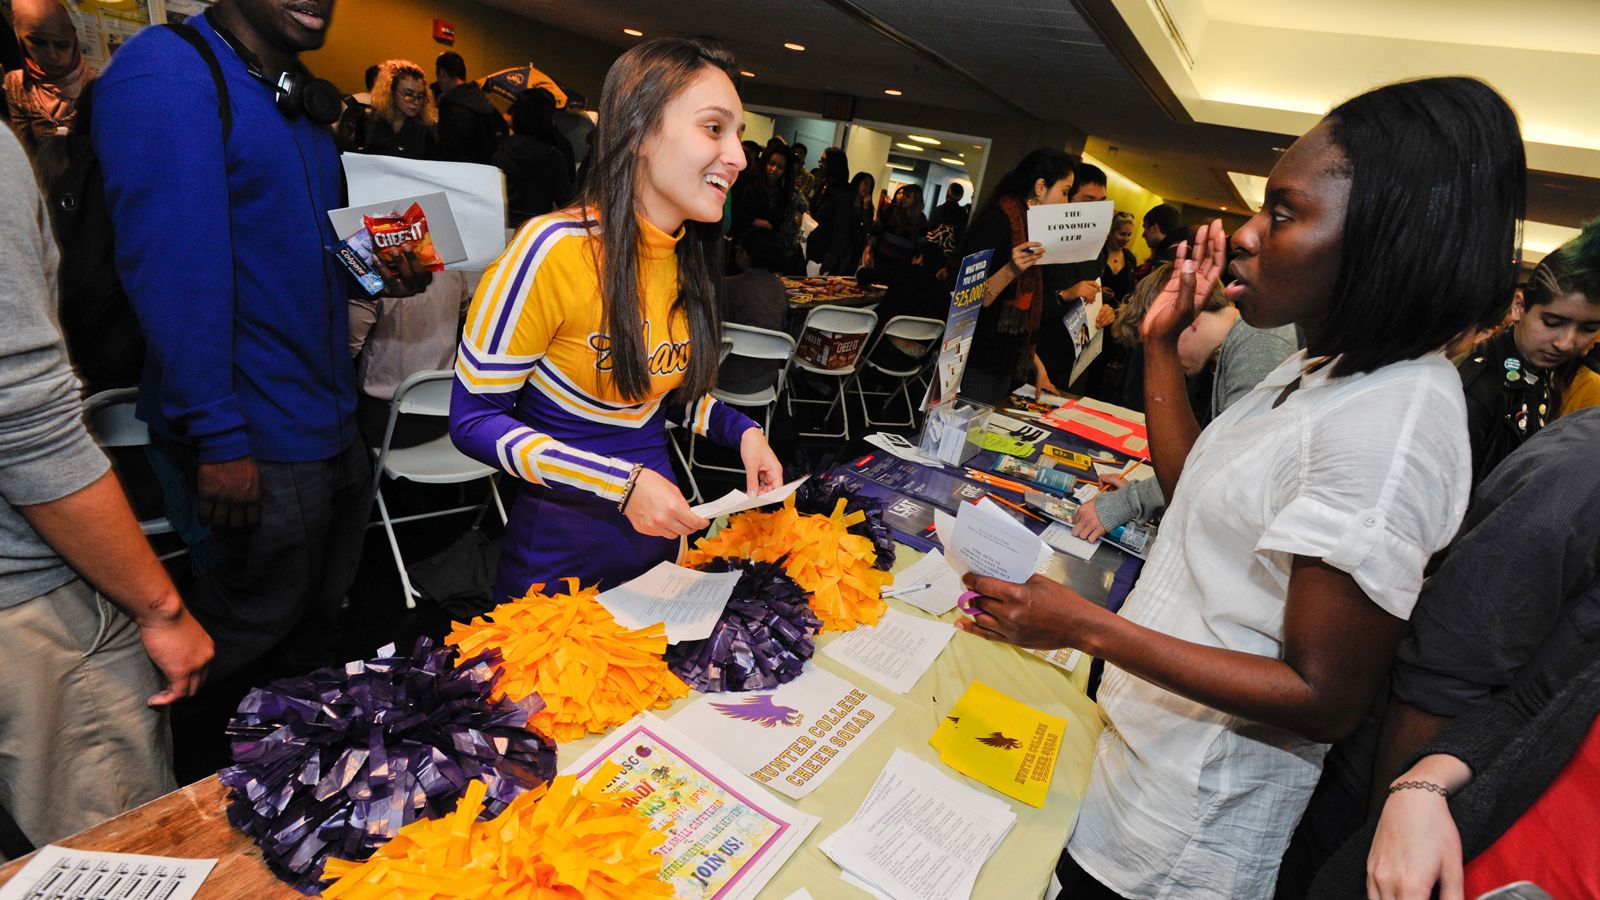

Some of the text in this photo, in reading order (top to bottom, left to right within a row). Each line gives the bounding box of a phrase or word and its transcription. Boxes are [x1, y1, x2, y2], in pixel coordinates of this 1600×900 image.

[1047, 221, 1097, 231] ECONOMICS
[1060, 234, 1082, 242] CLUB
[1064, 210, 1082, 218] THE
[340, 248, 366, 276] Colgate
[750, 688, 868, 783] HUNTER COLLEGE
[786, 708, 876, 787] CHEER SQUAD
[1014, 752, 1036, 785] HUNTER
[1028, 722, 1048, 753] COLLEGE
[1030, 755, 1049, 782] CHEER
[1040, 733, 1058, 756] SQUAD
[668, 827, 693, 848] SMALL
[688, 799, 725, 831] CAFETERIA
[659, 841, 706, 881] REFRESHMENTS
[690, 835, 745, 888] JOIN US!
